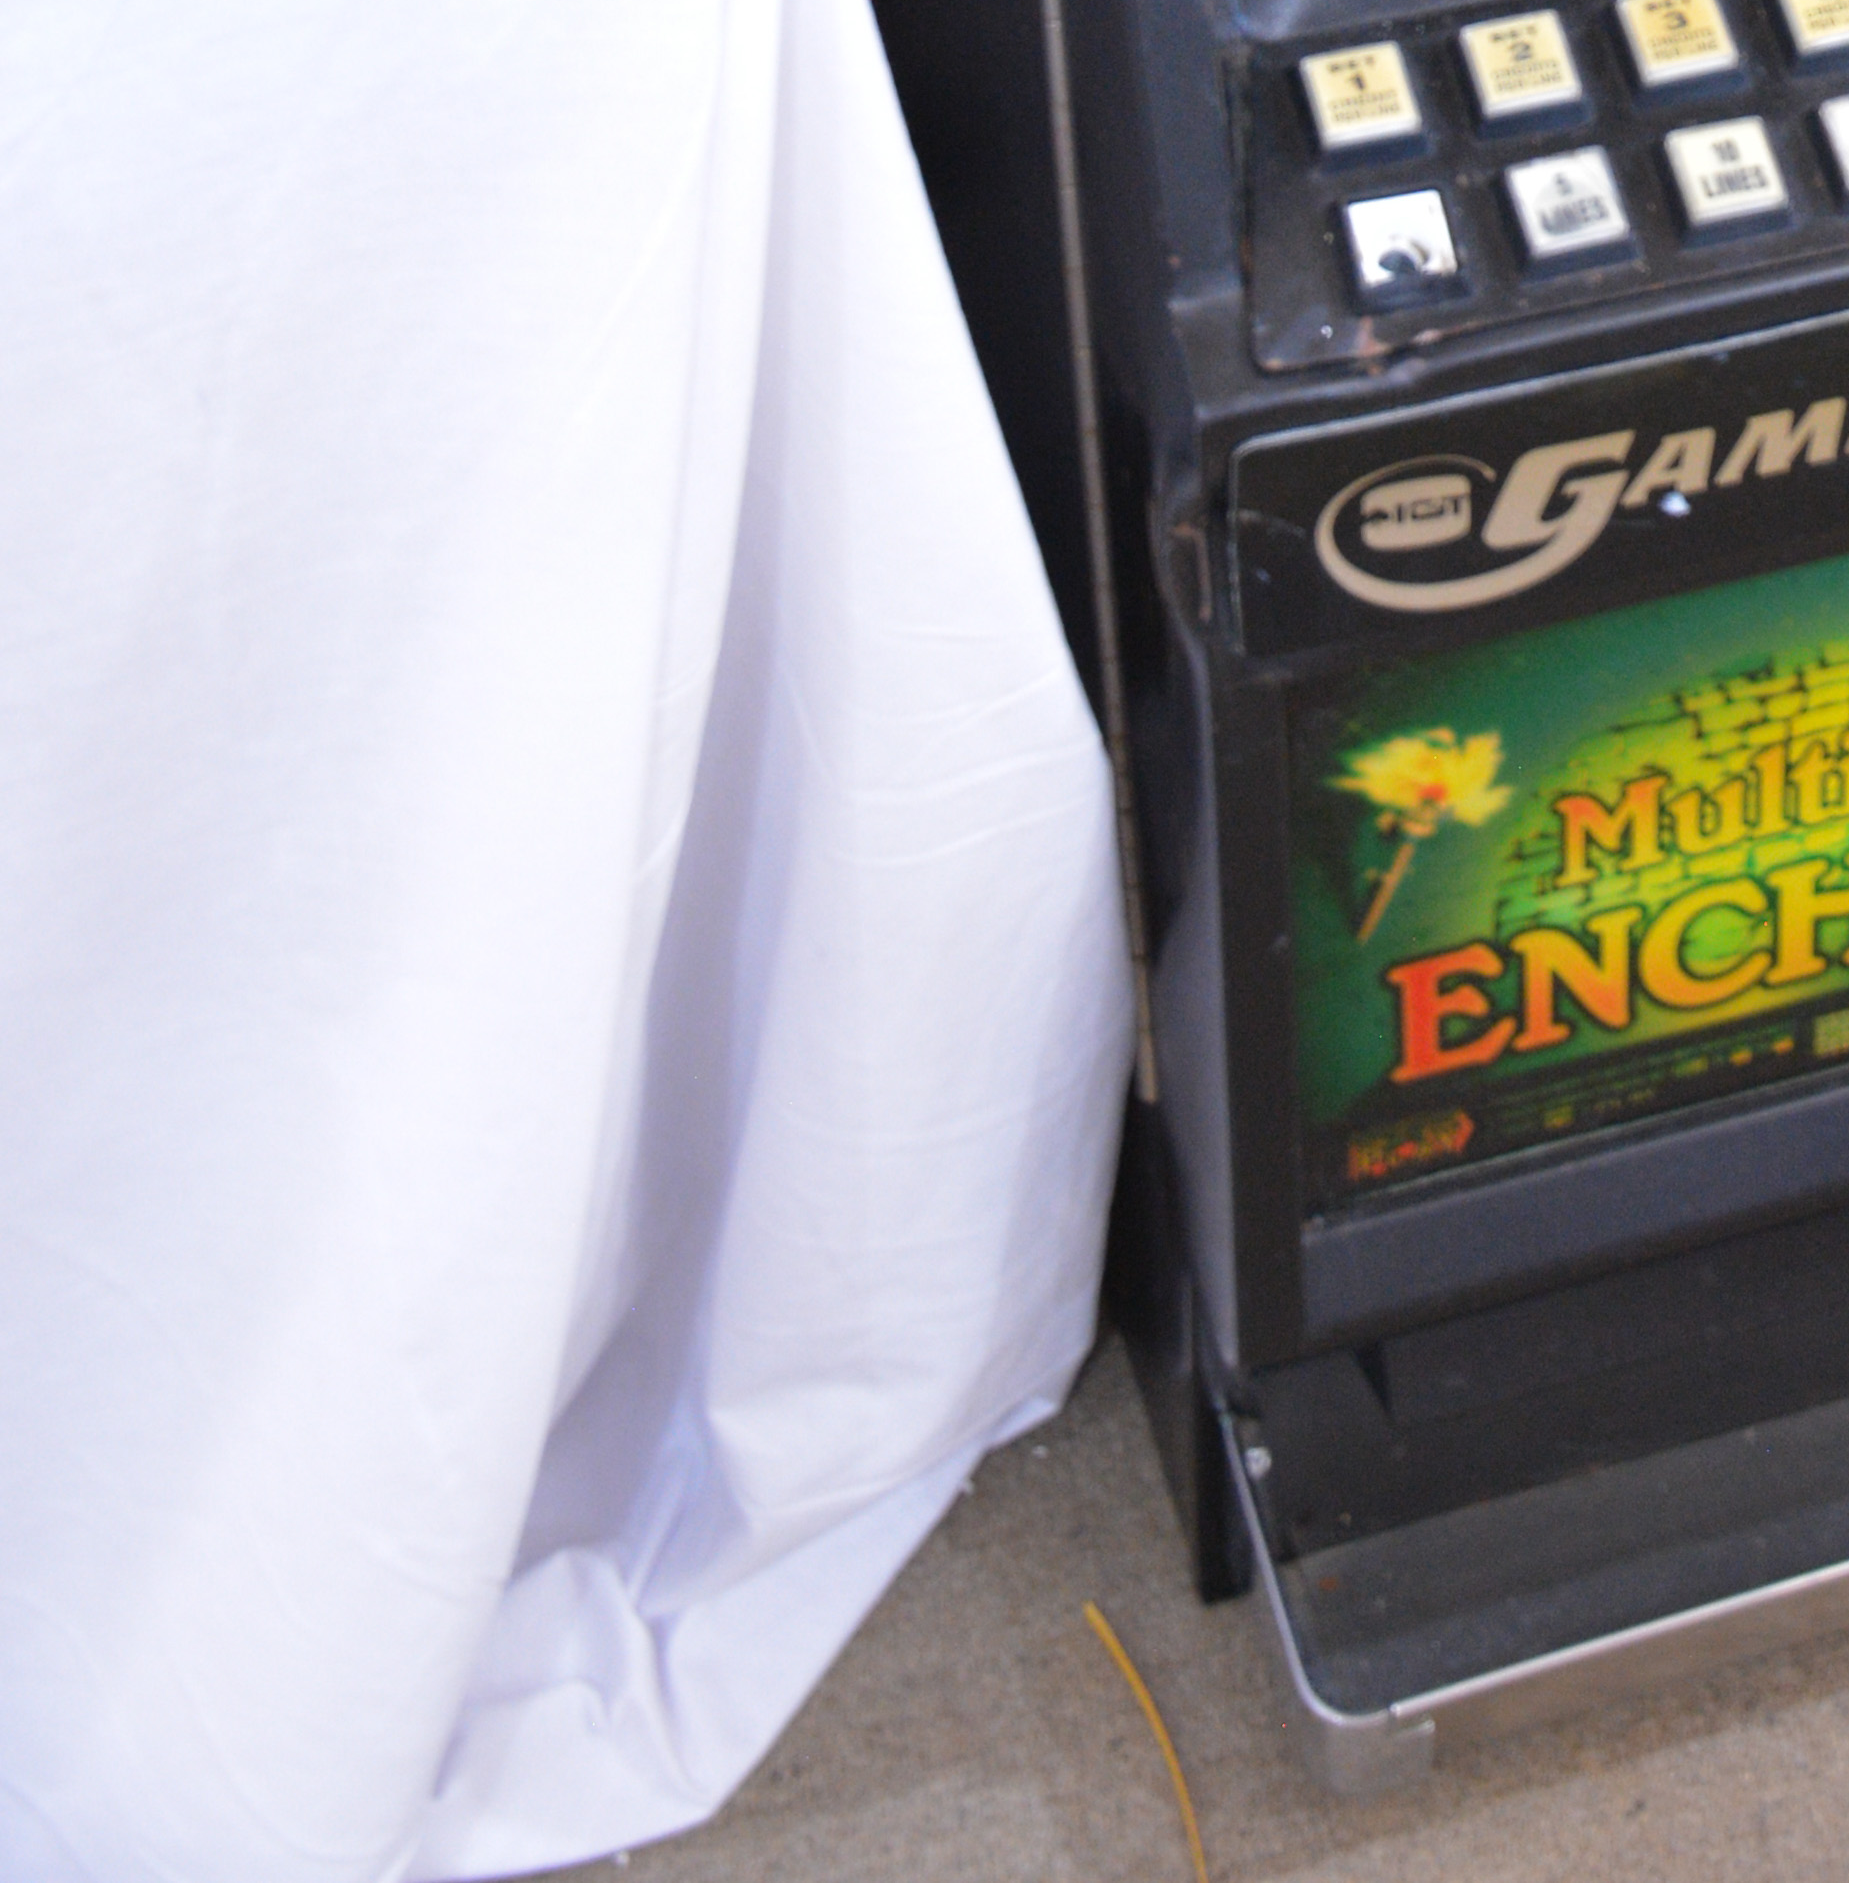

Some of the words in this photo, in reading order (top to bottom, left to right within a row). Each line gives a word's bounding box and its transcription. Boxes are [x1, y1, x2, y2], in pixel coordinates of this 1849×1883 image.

[1663, 10, 1687, 29] 3
[1509, 41, 1532, 61] 2
[1349, 72, 1366, 91] 1
[1711, 137, 1740, 163] 10
[1700, 164, 1769, 198] LINES
[1539, 195, 1610, 235] LINES
